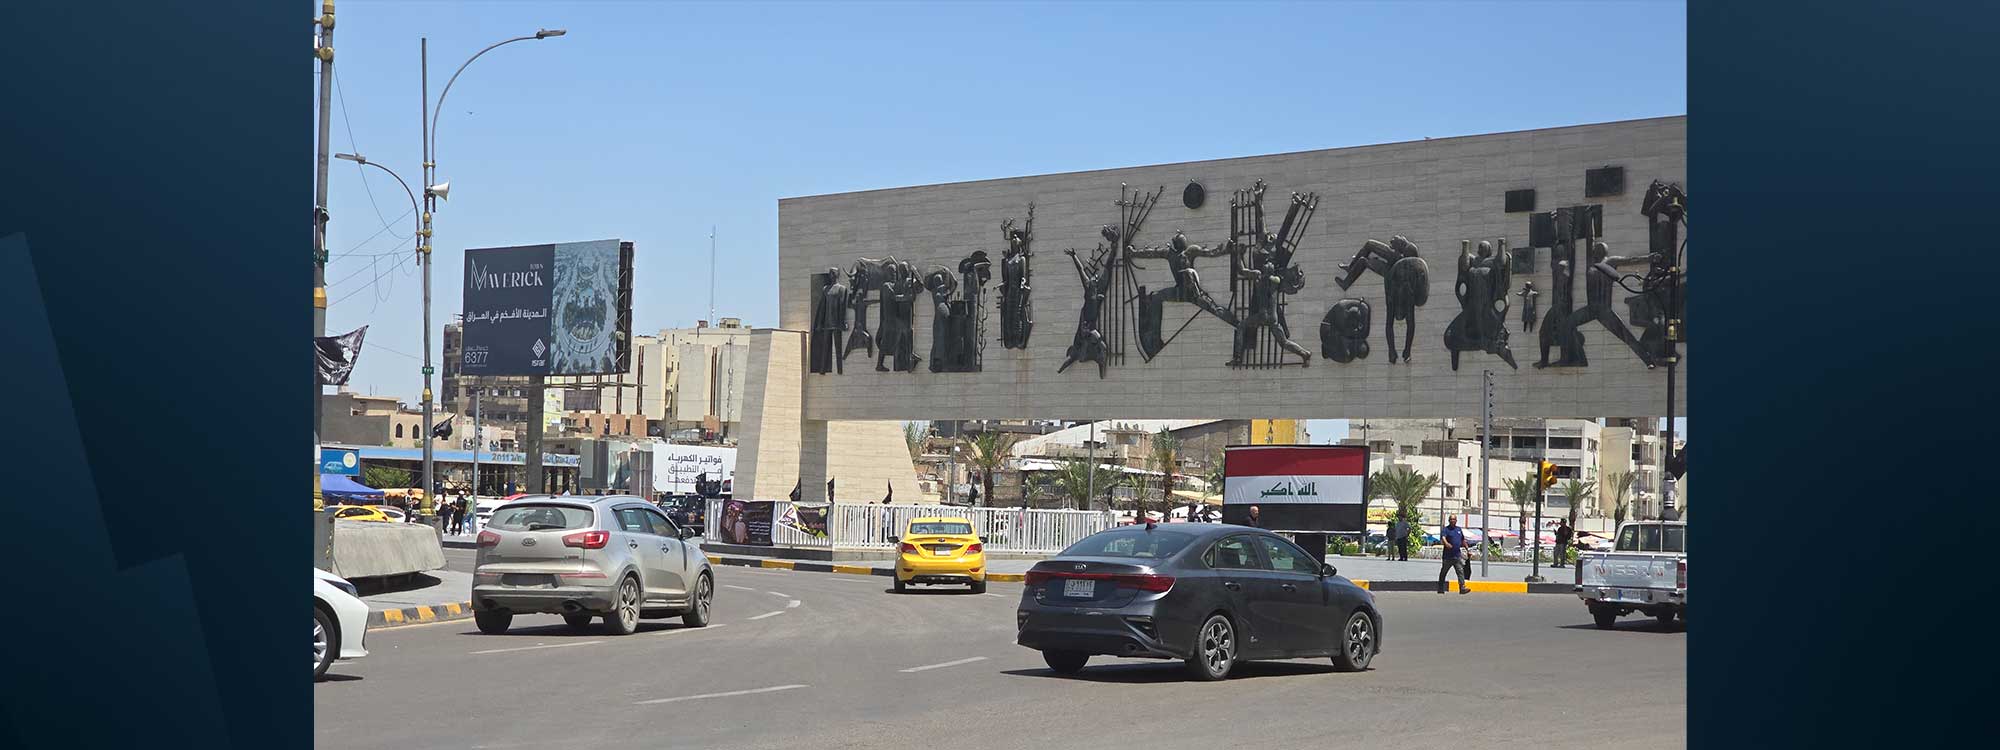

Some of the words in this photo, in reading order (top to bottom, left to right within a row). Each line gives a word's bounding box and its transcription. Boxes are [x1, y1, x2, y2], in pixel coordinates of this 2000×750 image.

[466, 310, 490, 323] العراق
[490, 310, 500, 324] في
[464, 351, 489, 364] 6377
[667, 452, 698, 464] الكهرباء
[699, 455, 722, 466] فواتير
[668, 463, 700, 475] التطبيق
[1297, 480, 1318, 496] الله
